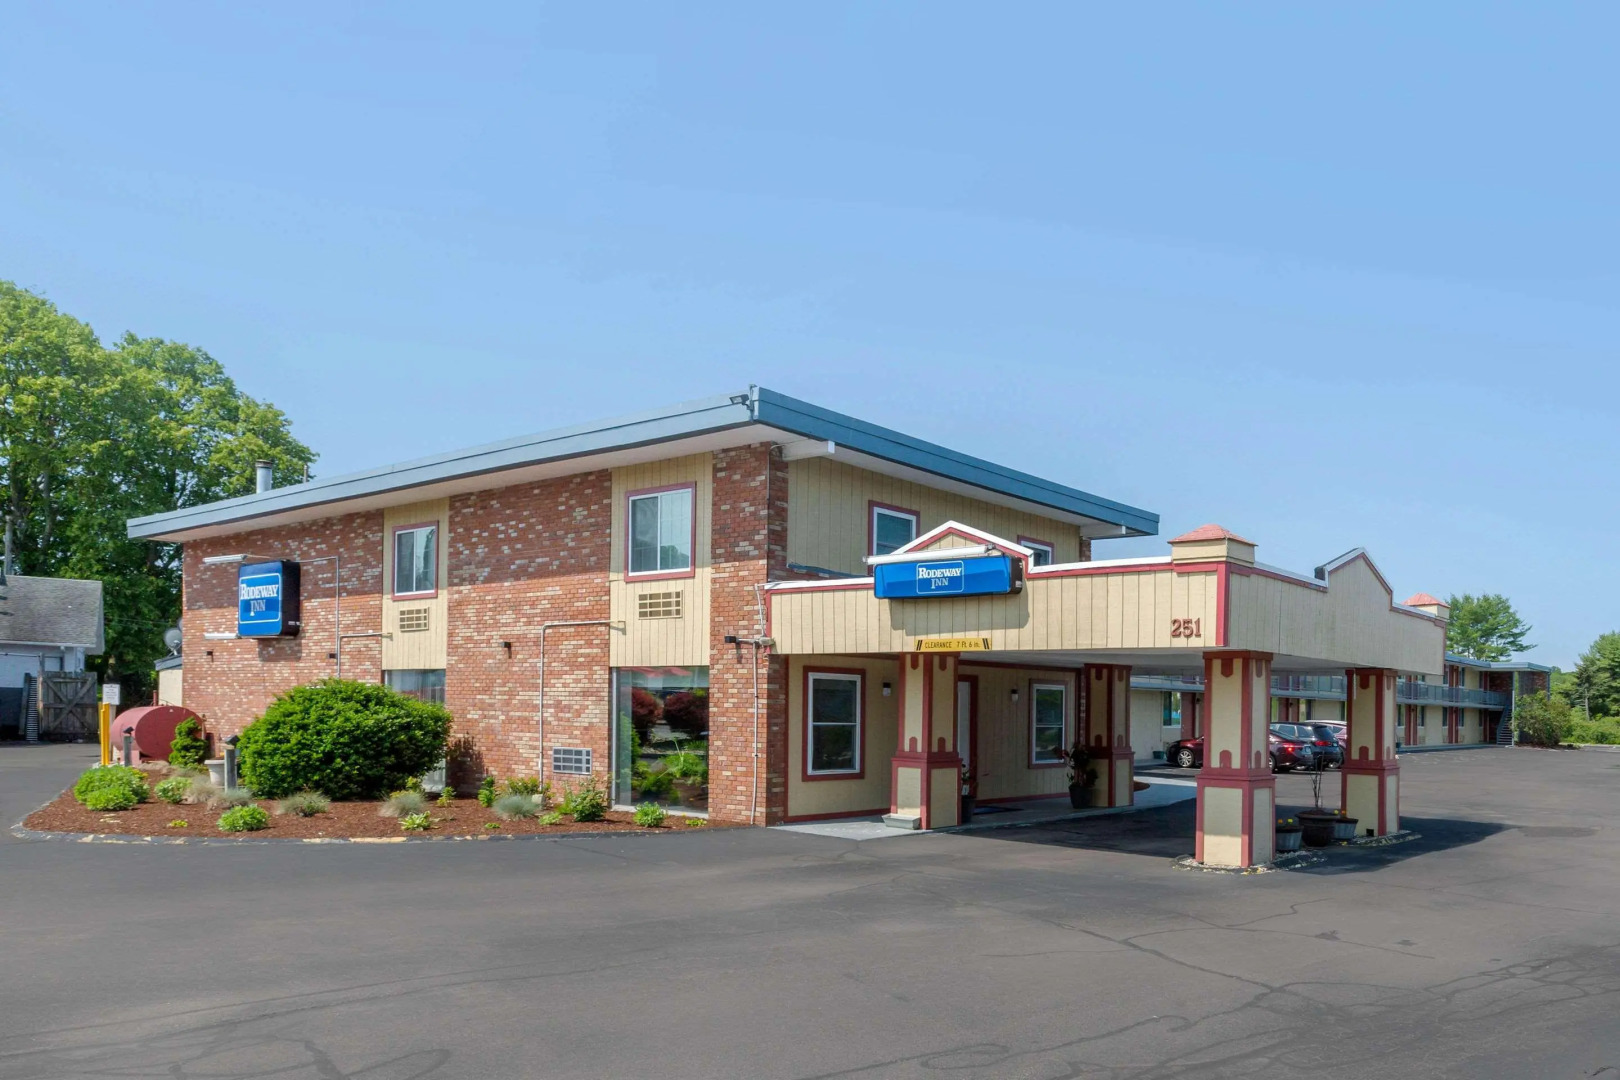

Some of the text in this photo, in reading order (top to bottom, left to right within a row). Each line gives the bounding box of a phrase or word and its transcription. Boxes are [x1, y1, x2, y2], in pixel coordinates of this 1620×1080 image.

[918, 567, 962, 578] RODEWAY
[240, 583, 279, 600] RODEWAY
[931, 578, 949, 589] INN
[250, 599, 266, 617] INN
[1171, 617, 1201, 638] 251
